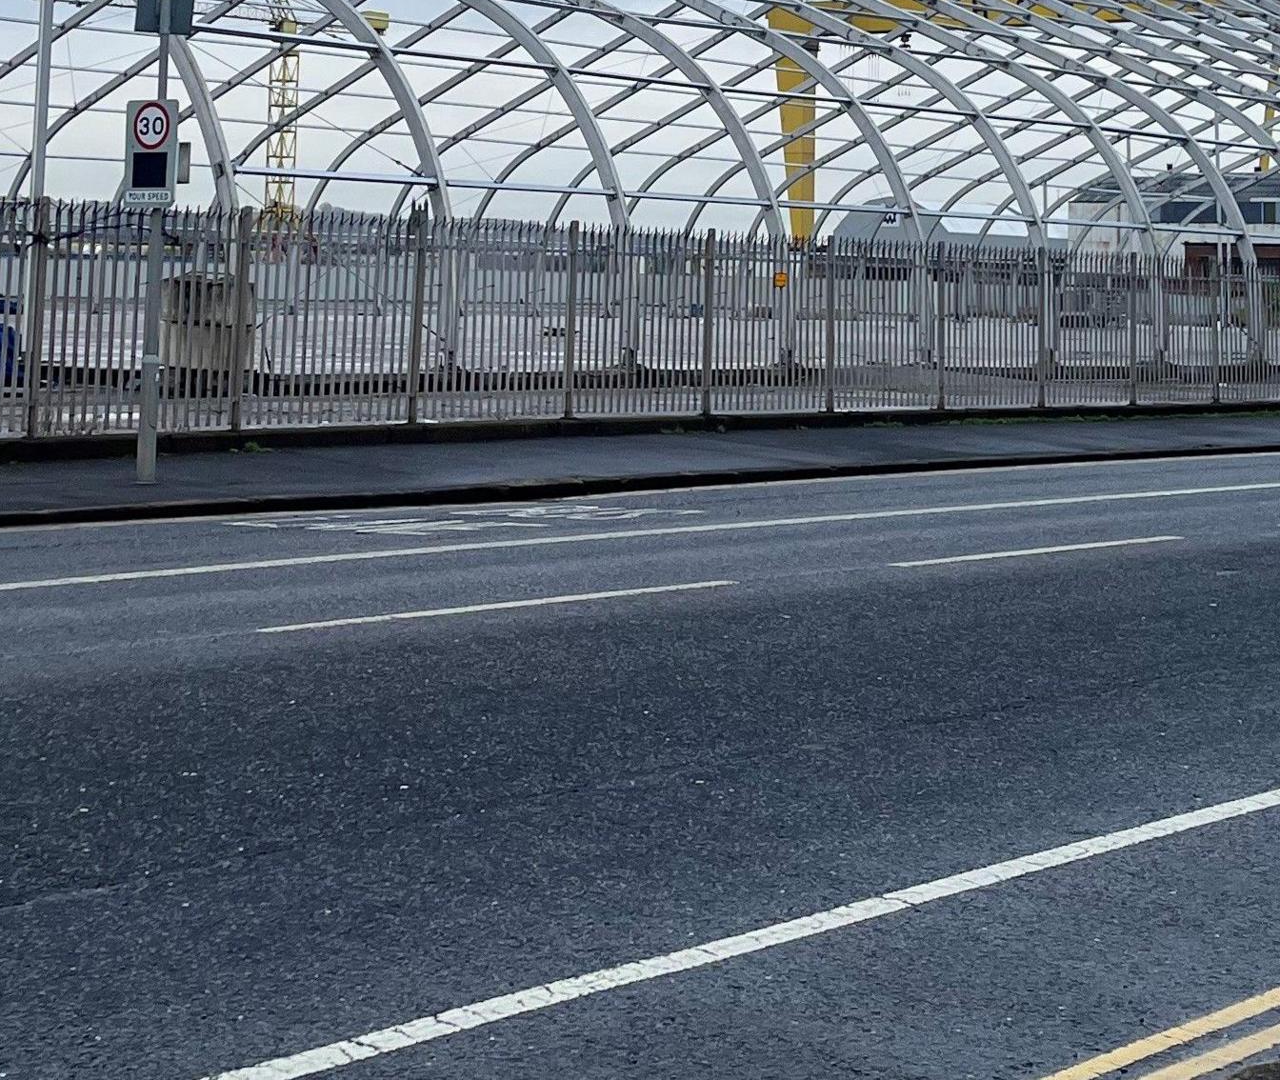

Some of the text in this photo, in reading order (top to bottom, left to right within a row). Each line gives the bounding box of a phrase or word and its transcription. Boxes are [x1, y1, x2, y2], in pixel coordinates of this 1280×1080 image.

[139, 116, 164, 136] 30
[129, 192, 168, 201] YOUR SPEED
